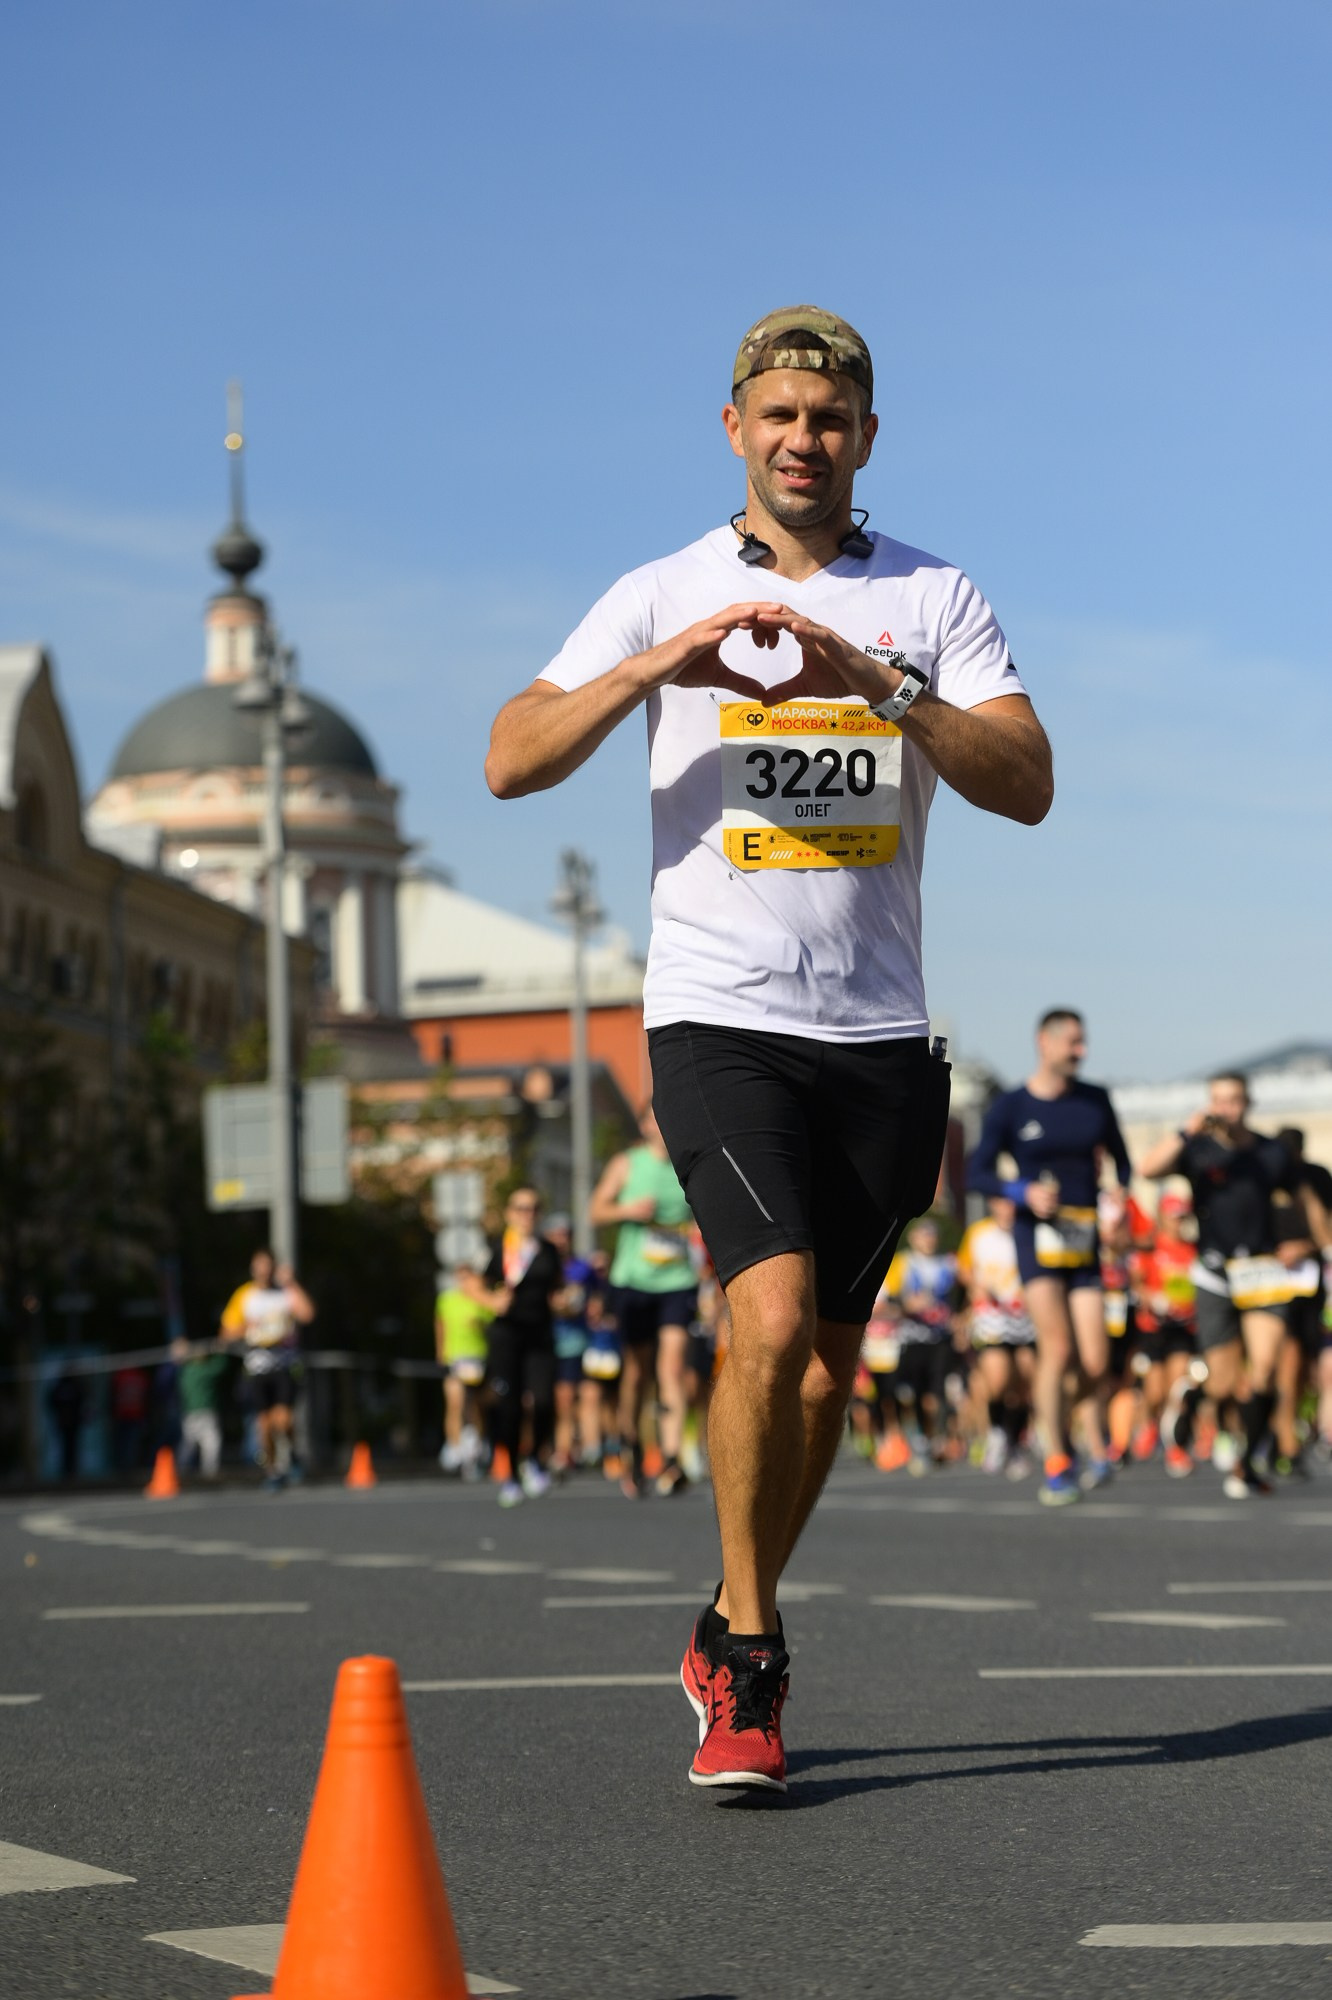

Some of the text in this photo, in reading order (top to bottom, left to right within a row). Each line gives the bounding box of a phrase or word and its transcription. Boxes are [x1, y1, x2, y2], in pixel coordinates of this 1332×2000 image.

[771, 707, 839, 719] МАРАФОН
[771, 719, 887, 732] МОСКВА 42,2 КМ
[745, 748, 876, 799] 3220
[795, 804, 831, 818] ОЛЕГ
